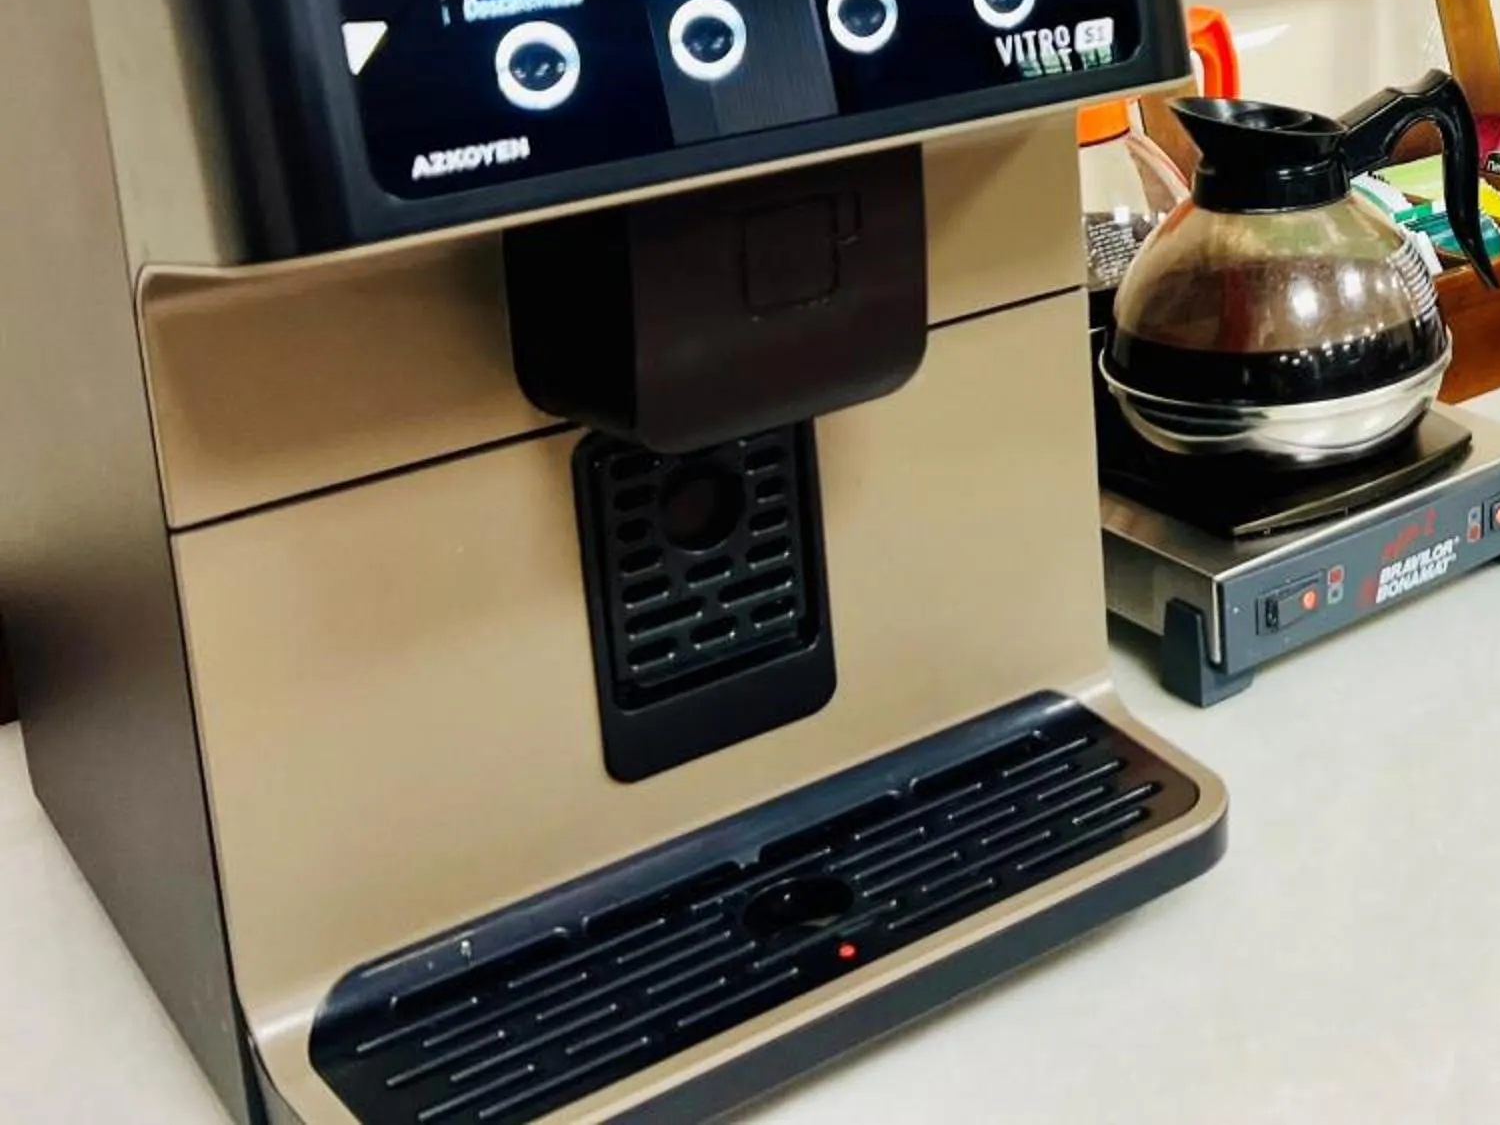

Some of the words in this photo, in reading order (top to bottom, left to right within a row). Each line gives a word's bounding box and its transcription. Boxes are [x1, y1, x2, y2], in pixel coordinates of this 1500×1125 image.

[995, 24, 1071, 67] VITRO
[412, 135, 530, 179] AZKOYEN
[1376, 559, 1451, 604] BONAMAT
[1379, 538, 1454, 583] BRAVILOR
